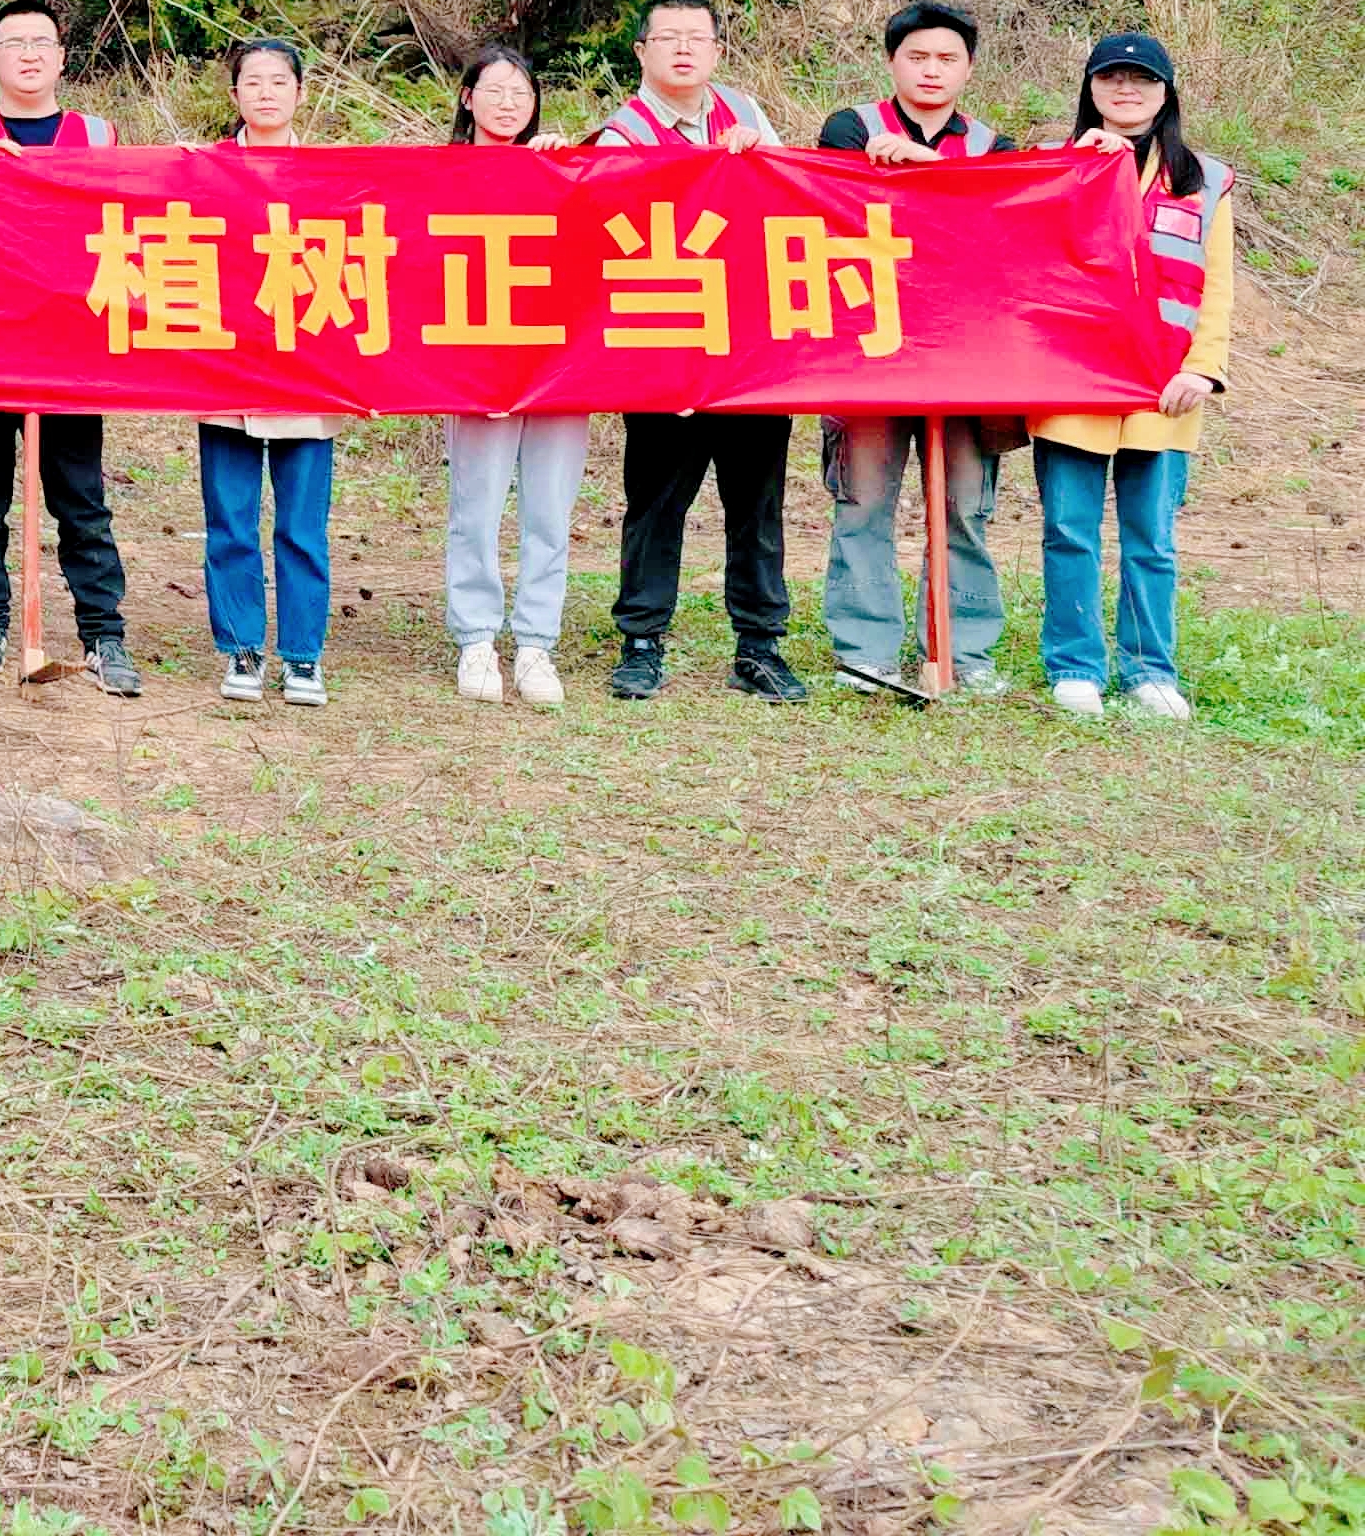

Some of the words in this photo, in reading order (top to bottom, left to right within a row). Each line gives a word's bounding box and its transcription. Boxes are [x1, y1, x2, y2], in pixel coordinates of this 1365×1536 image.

[84, 199, 914, 358] 植树正当时
